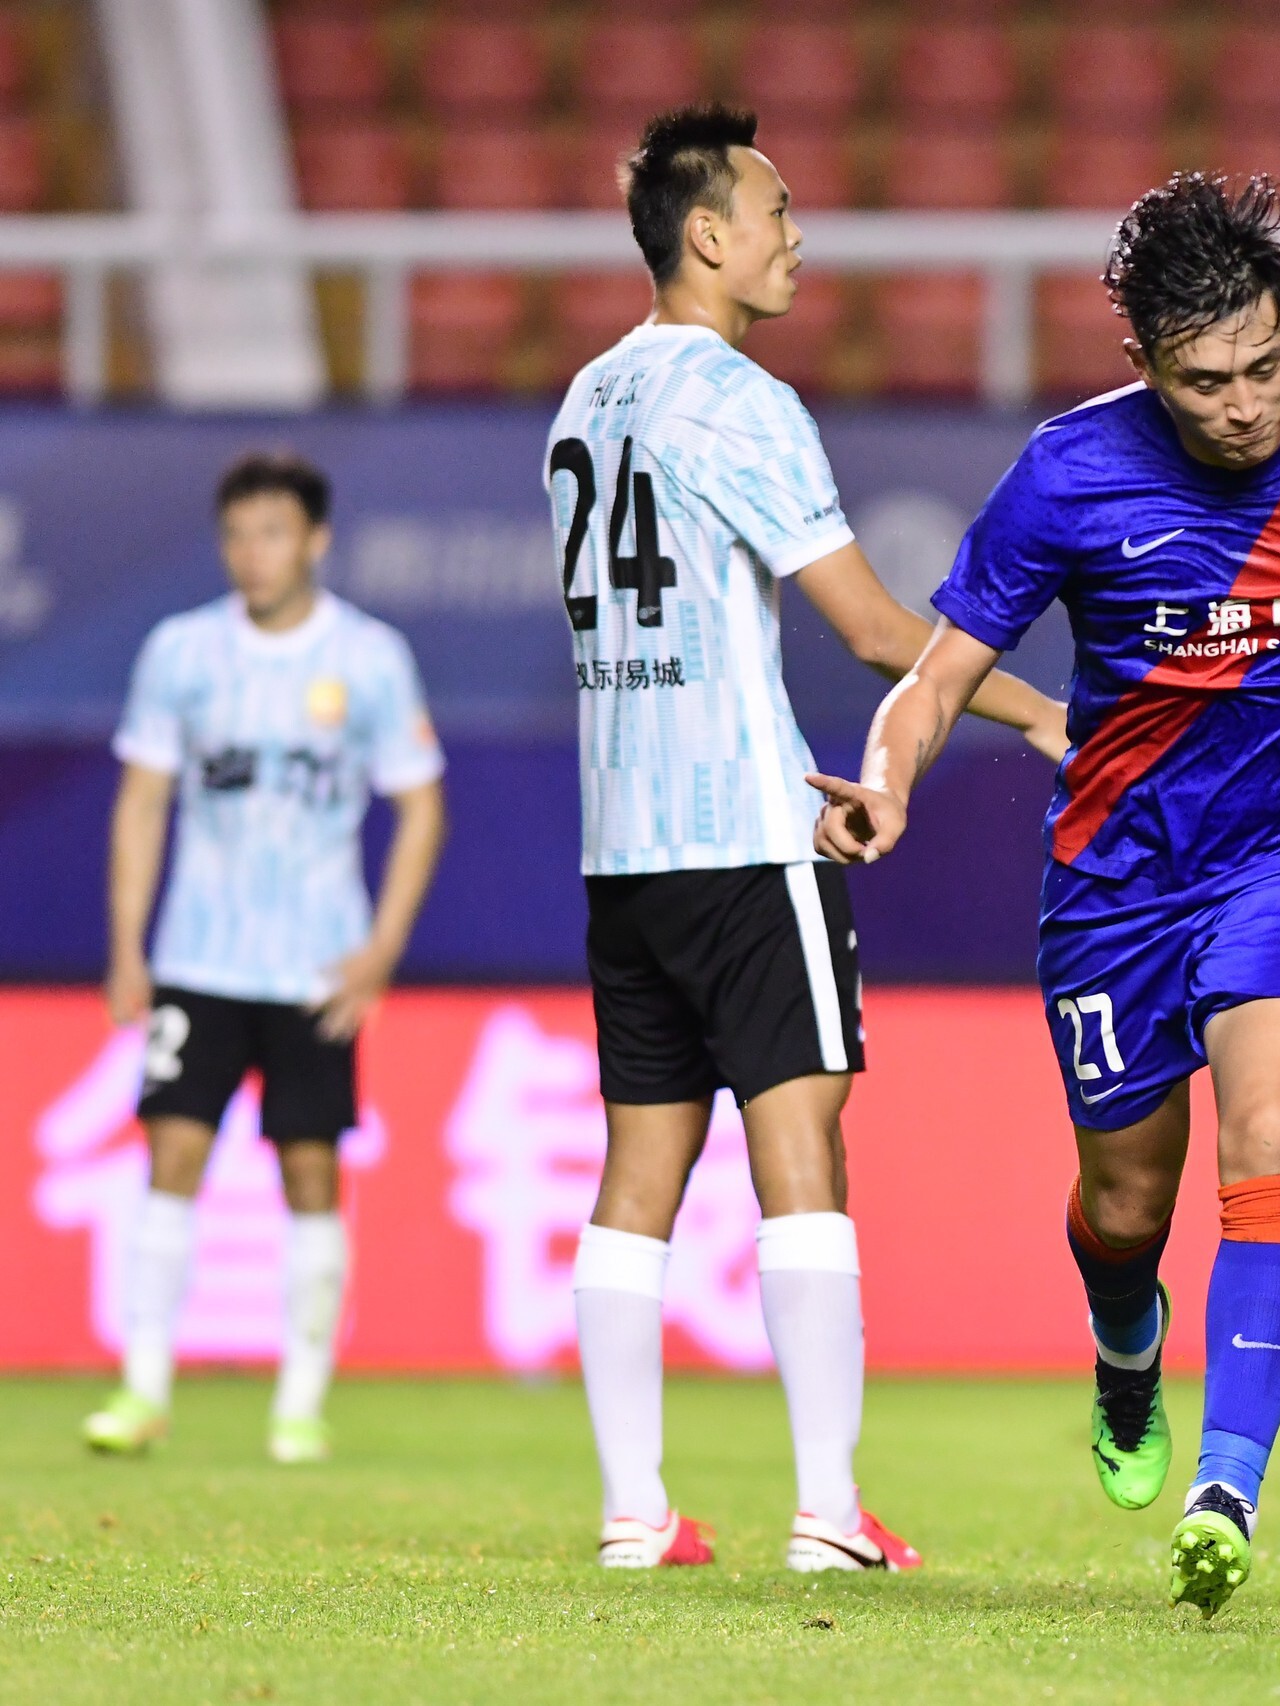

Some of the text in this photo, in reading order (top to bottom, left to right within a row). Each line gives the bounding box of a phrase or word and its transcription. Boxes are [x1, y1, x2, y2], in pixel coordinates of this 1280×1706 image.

[550, 435, 677, 632] 24
[1143, 637, 1259, 658] SHANGHAI
[1057, 992, 1126, 1080] 27
